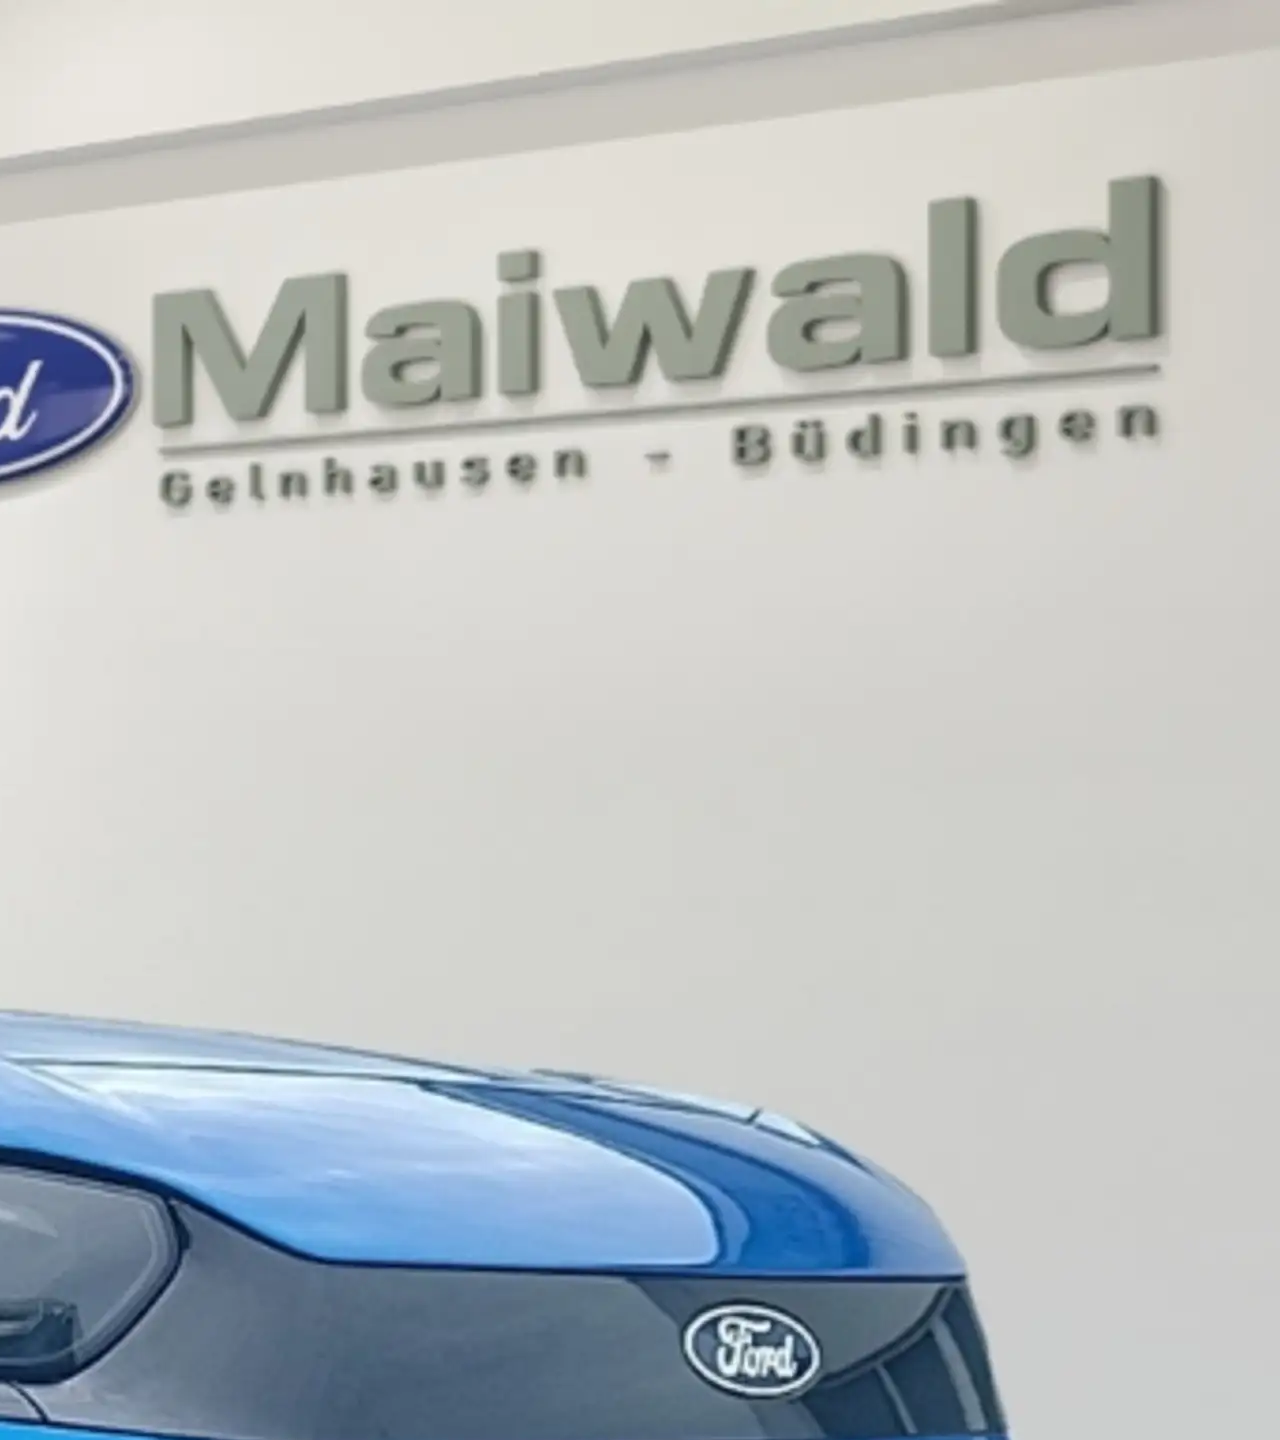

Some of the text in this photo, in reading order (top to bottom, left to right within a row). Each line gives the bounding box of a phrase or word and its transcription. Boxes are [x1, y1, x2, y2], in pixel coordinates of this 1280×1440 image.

[151, 176, 1162, 430] Maiwald
[160, 457, 589, 506] Gelnhausen
[732, 405, 1160, 466] Büdingen
[717, 1316, 798, 1378] Ford
